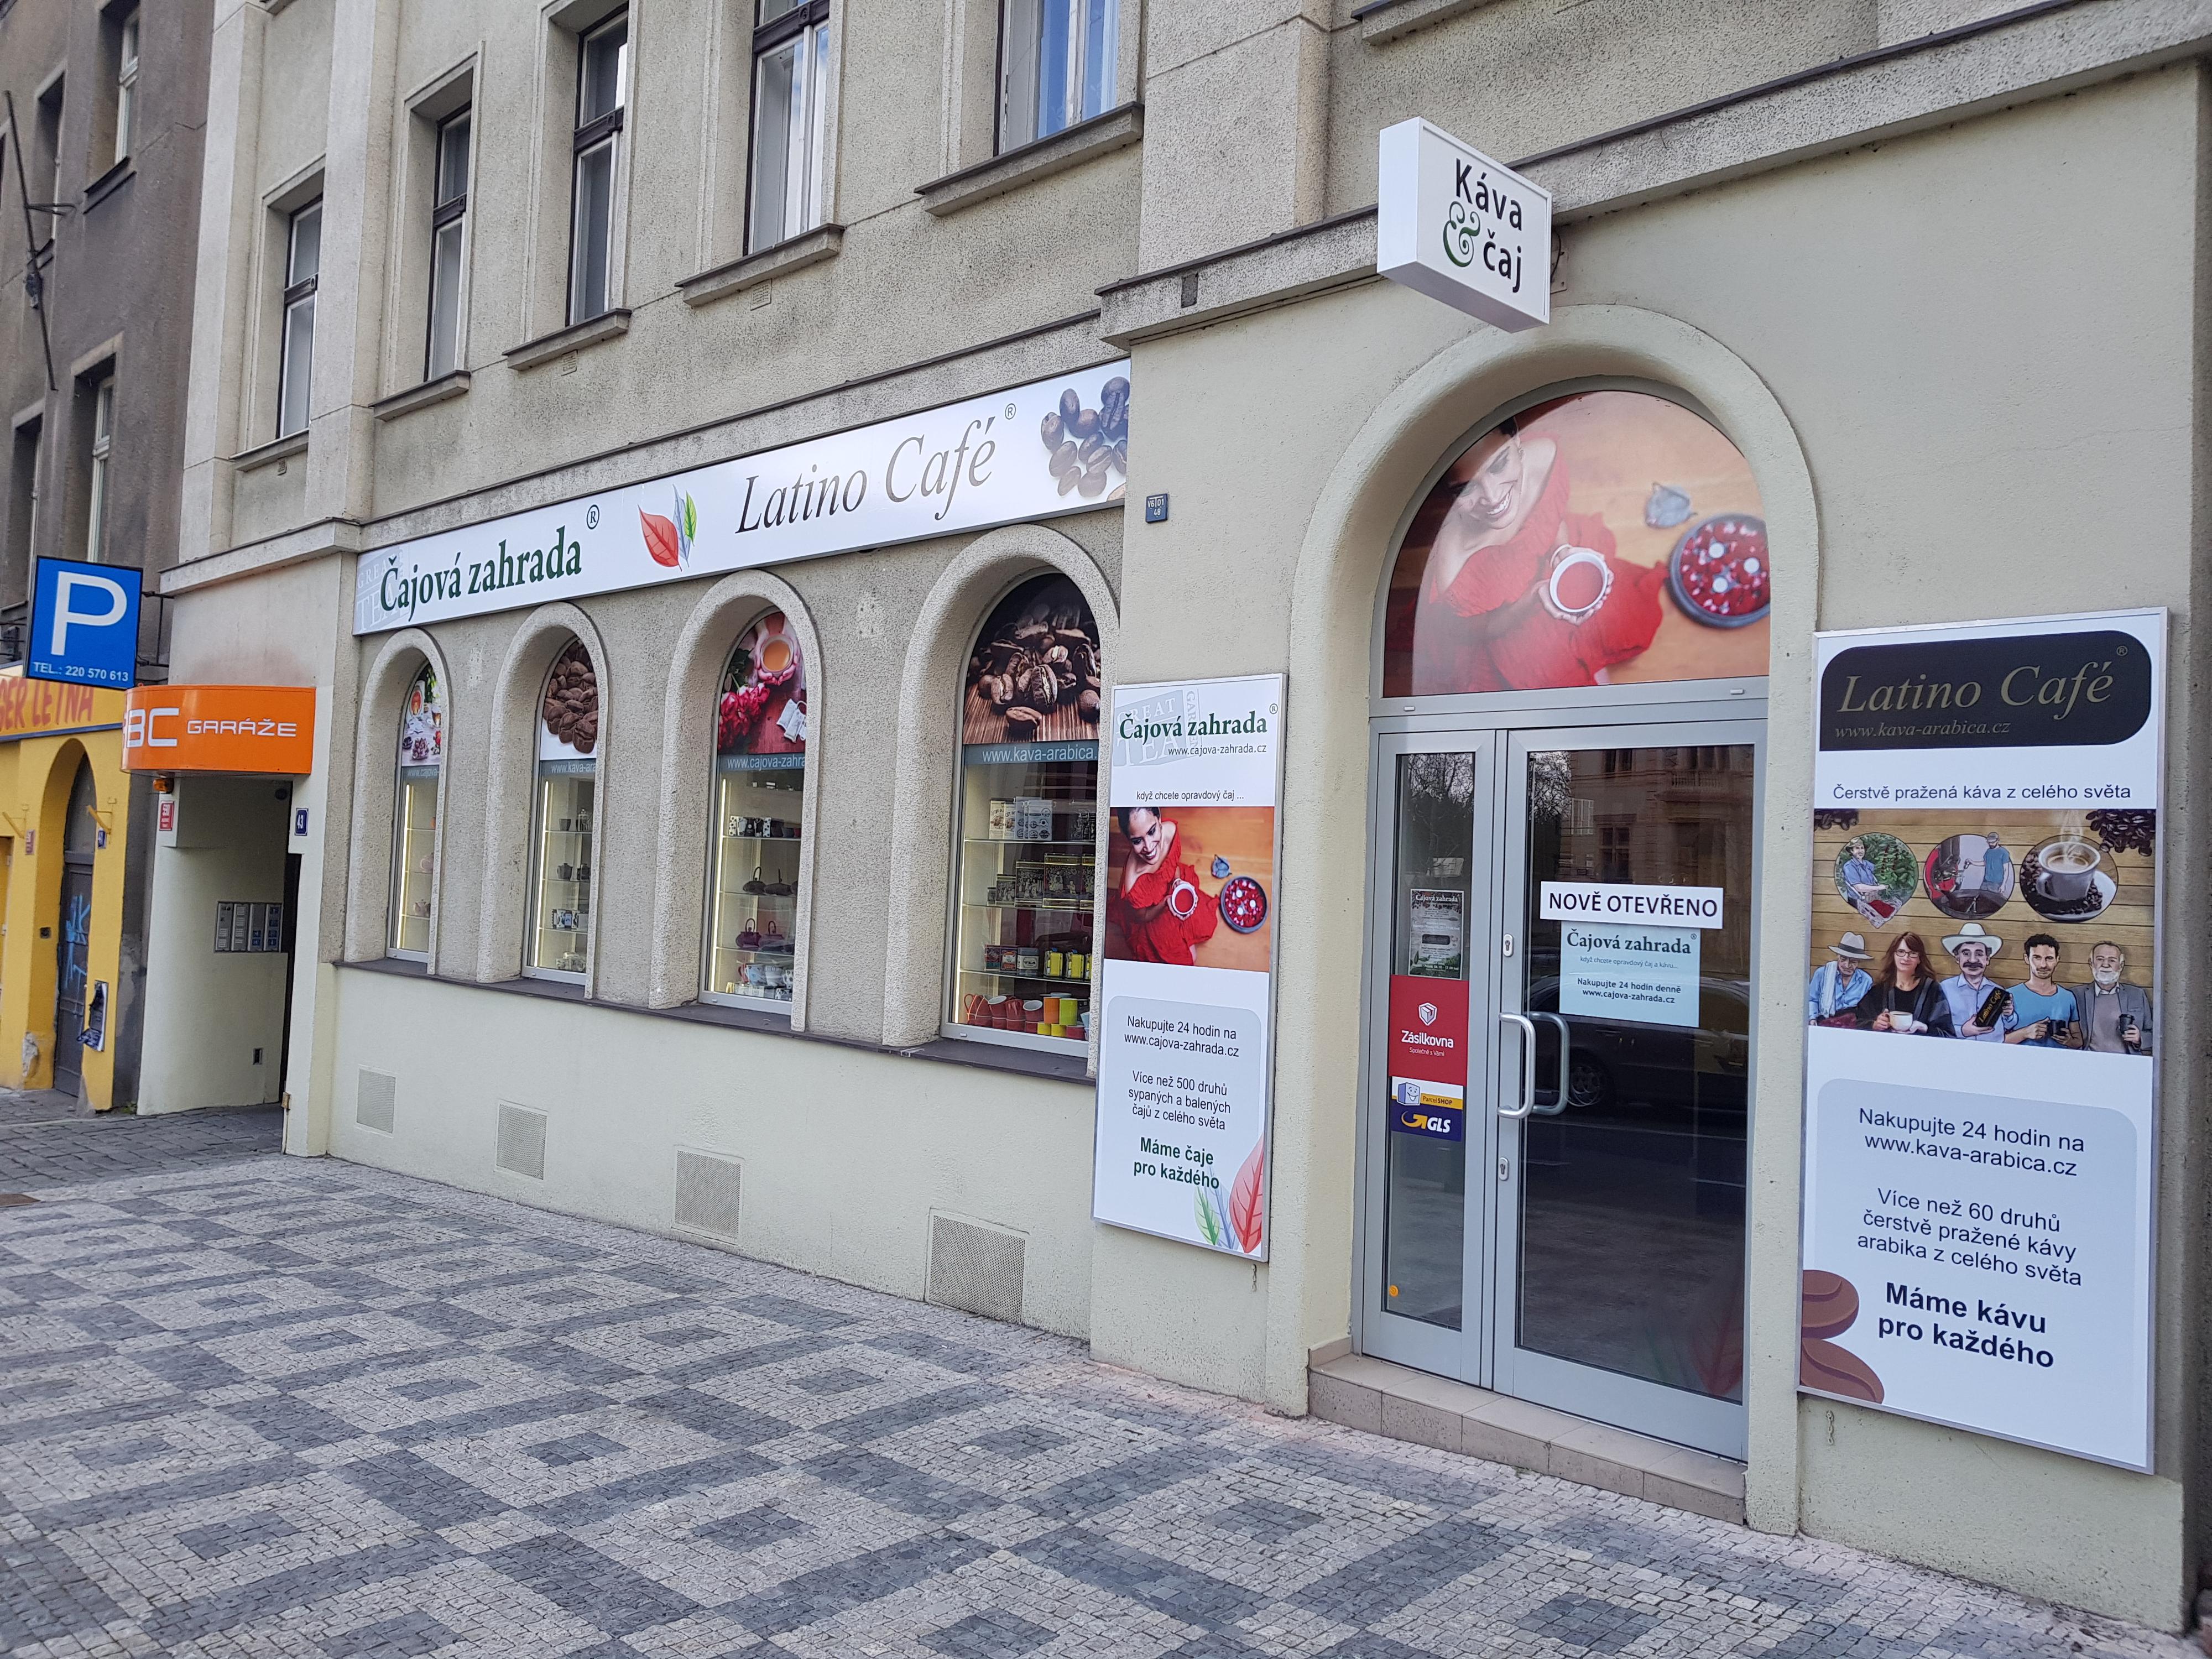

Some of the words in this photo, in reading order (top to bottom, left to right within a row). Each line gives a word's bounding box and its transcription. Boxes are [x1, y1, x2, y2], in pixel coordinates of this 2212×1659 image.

[1456, 158, 1522, 231] Káva
[1483, 228, 1521, 293] čaj
[735, 464, 868, 534] Latino
[885, 416, 997, 520] Café
[381, 552, 461, 622] Čajová
[468, 525, 581, 594] zahrada
[51, 571, 127, 655] P
[65, 665, 84, 676] 220
[88, 668, 107, 679] 570
[110, 671, 128, 681] 613
[1837, 674, 1981, 713] Latino
[2001, 661, 2114, 720] Café
[187, 718, 297, 737] GARÁŽE
[1120, 713, 1182, 745] Čajová
[1188, 711, 1267, 735] zahrada
[1835, 719, 2011, 738] www.kava-arabica.cz
[1168, 743, 1266, 756] www.cajova-zahrada.cz
[1137, 791, 1153, 801] když
[1155, 791, 1178, 800] chcete
[1182, 790, 1220, 801] opravdový
[1223, 790, 1234, 801] čaj
[1834, 784, 1889, 800] Čerstvě
[1895, 784, 1957, 802] pražená
[1964, 785, 2001, 799] káva
[2007, 788, 2016, 799] z
[2022, 784, 2078, 799] celého
[2084, 784, 2131, 799] světa
[1550, 891, 1601, 911] NOVĚ
[1608, 894, 1717, 917] OTEVŘENO
[1567, 928, 1621, 952] Čajová
[1625, 936, 1691, 954] zahrada
[1578, 978, 1616, 988] Nakupujte
[1631, 982, 1653, 991] hodin
[1656, 985, 1681, 993] denně
[1583, 989, 1675, 1003] www.cajova-zahrada.cz
[1128, 1015, 1174, 1034] Nakupujte
[1177, 1022, 1189, 1033] 24
[1193, 1025, 1220, 1037] hodin
[1224, 1029, 1236, 1040] na
[1401, 1030, 1454, 1048] Zásilkovna
[1124, 1034, 1239, 1057] www.cajova-zahrada.cz
[1133, 1071, 1153, 1084] Více
[1156, 1076, 1173, 1087] než
[1177, 1078, 1194, 1091] 500
[1198, 1081, 1227, 1095] druhů
[1129, 1089, 1172, 1104] sypaných
[1186, 1096, 1230, 1114] balených
[1422, 1096, 1452, 1105] ParcelSHOP
[1133, 1104, 1151, 1119] čajů
[1155, 1110, 1160, 1119] z
[1163, 1111, 1194, 1124] celého
[1198, 1117, 1225, 1130] světa
[1427, 1117, 1451, 1133] GLS
[1860, 1108, 1955, 1137] Nakupujte
[1963, 1121, 1987, 1139] 24
[1995, 1125, 2050, 1147] hodin
[2059, 1136, 2084, 1152] na
[1141, 1137, 1180, 1159] Máme
[1185, 1145, 1213, 1167] čaje
[1865, 1135, 2077, 1176] www.kava-arabica.cz
[1134, 1162, 1155, 1176] pro
[1161, 1163, 1219, 1189] každého
[1877, 1188, 1919, 1209] Více
[1927, 1199, 1962, 1217] než
[1969, 1203, 1993, 1221] 60
[2001, 1208, 2060, 1232] druhů
[1864, 1209, 1932, 1235] čerstvě
[1939, 1225, 2020, 1251] pražené
[2028, 1235, 2077, 1263] kávy
[1858, 1235, 1927, 1259] arabika
[1934, 1249, 1944, 1262] z
[1952, 1250, 2017, 1275] celého
[2025, 1264, 2082, 1286] světa
[1886, 1282, 1968, 1317] Máme
[1978, 1300, 2046, 1333] kávu
[1879, 1317, 1923, 1340] pro
[1933, 1323, 2054, 1368] každého
